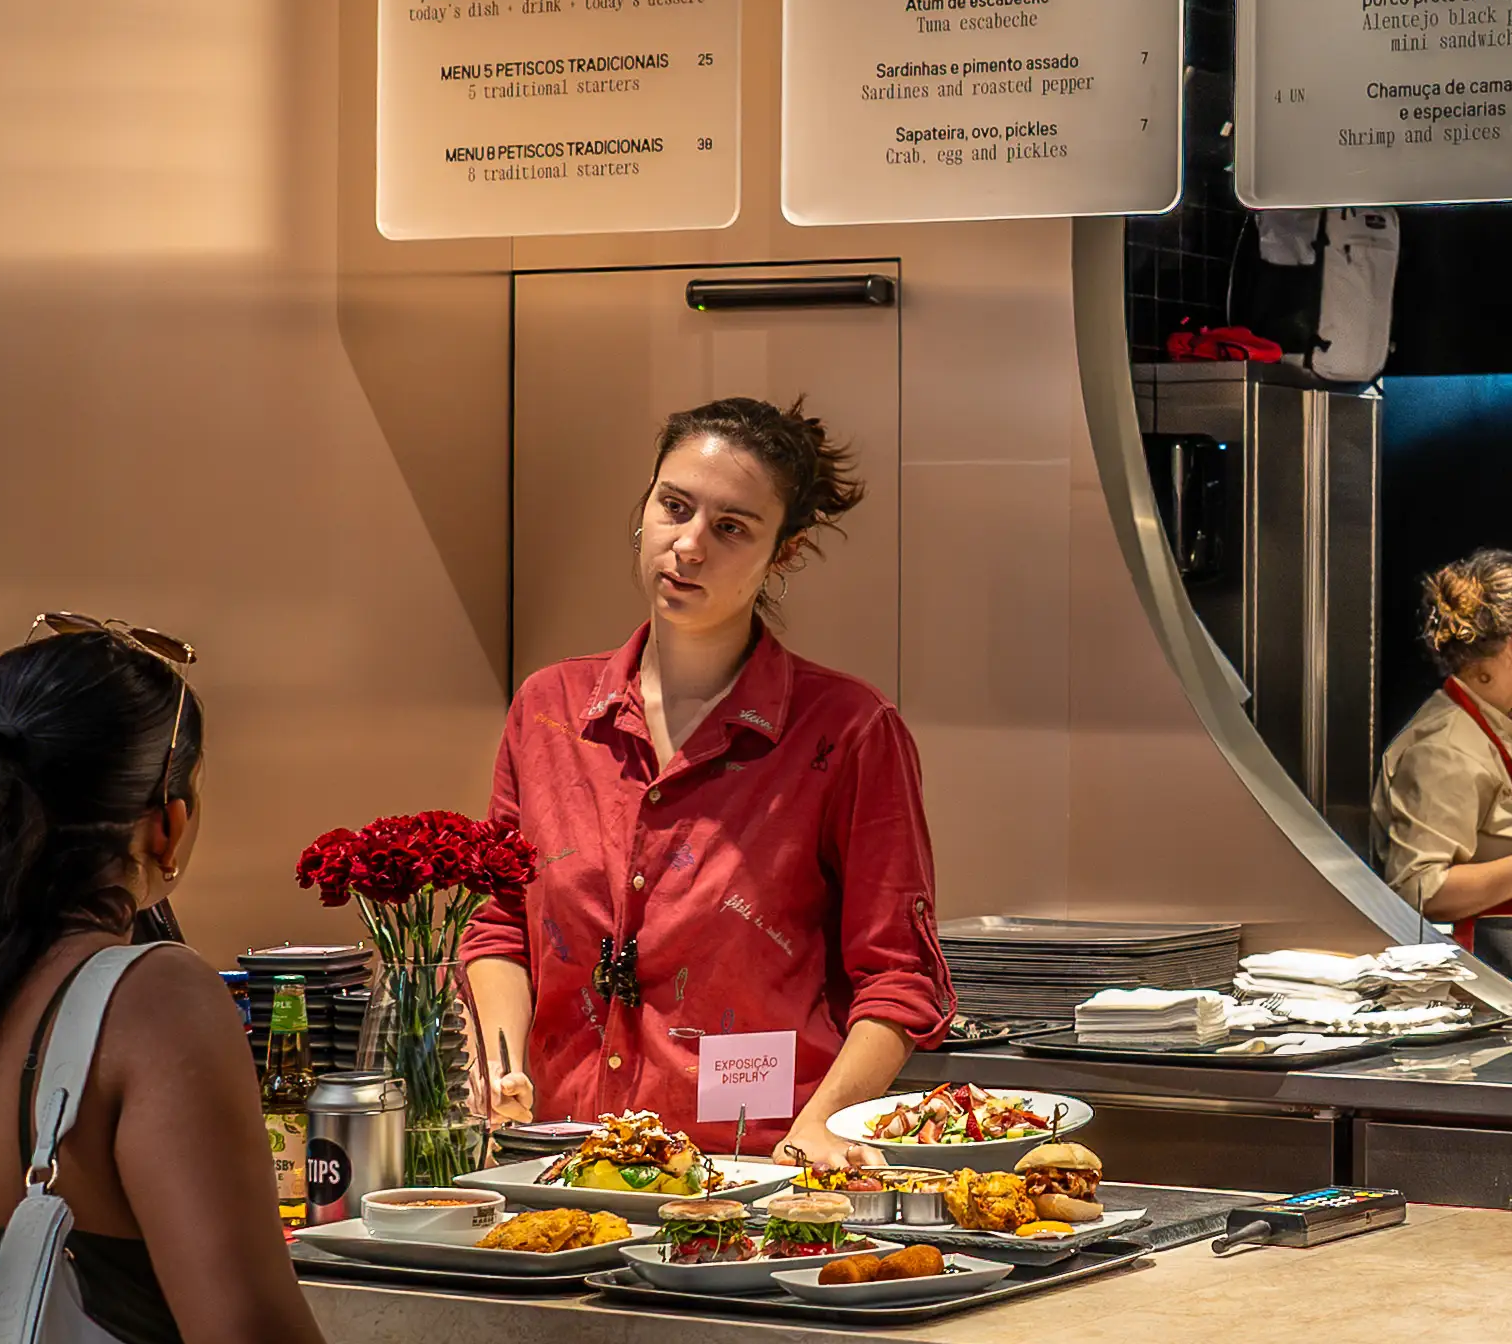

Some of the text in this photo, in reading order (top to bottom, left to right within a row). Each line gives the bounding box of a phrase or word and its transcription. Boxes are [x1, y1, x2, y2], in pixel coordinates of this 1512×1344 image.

[714, 1055, 778, 1073] EXPOSIÇÃO
[722, 1070, 769, 1084] DISPLAY
[307, 1158, 340, 1184] TIPS
